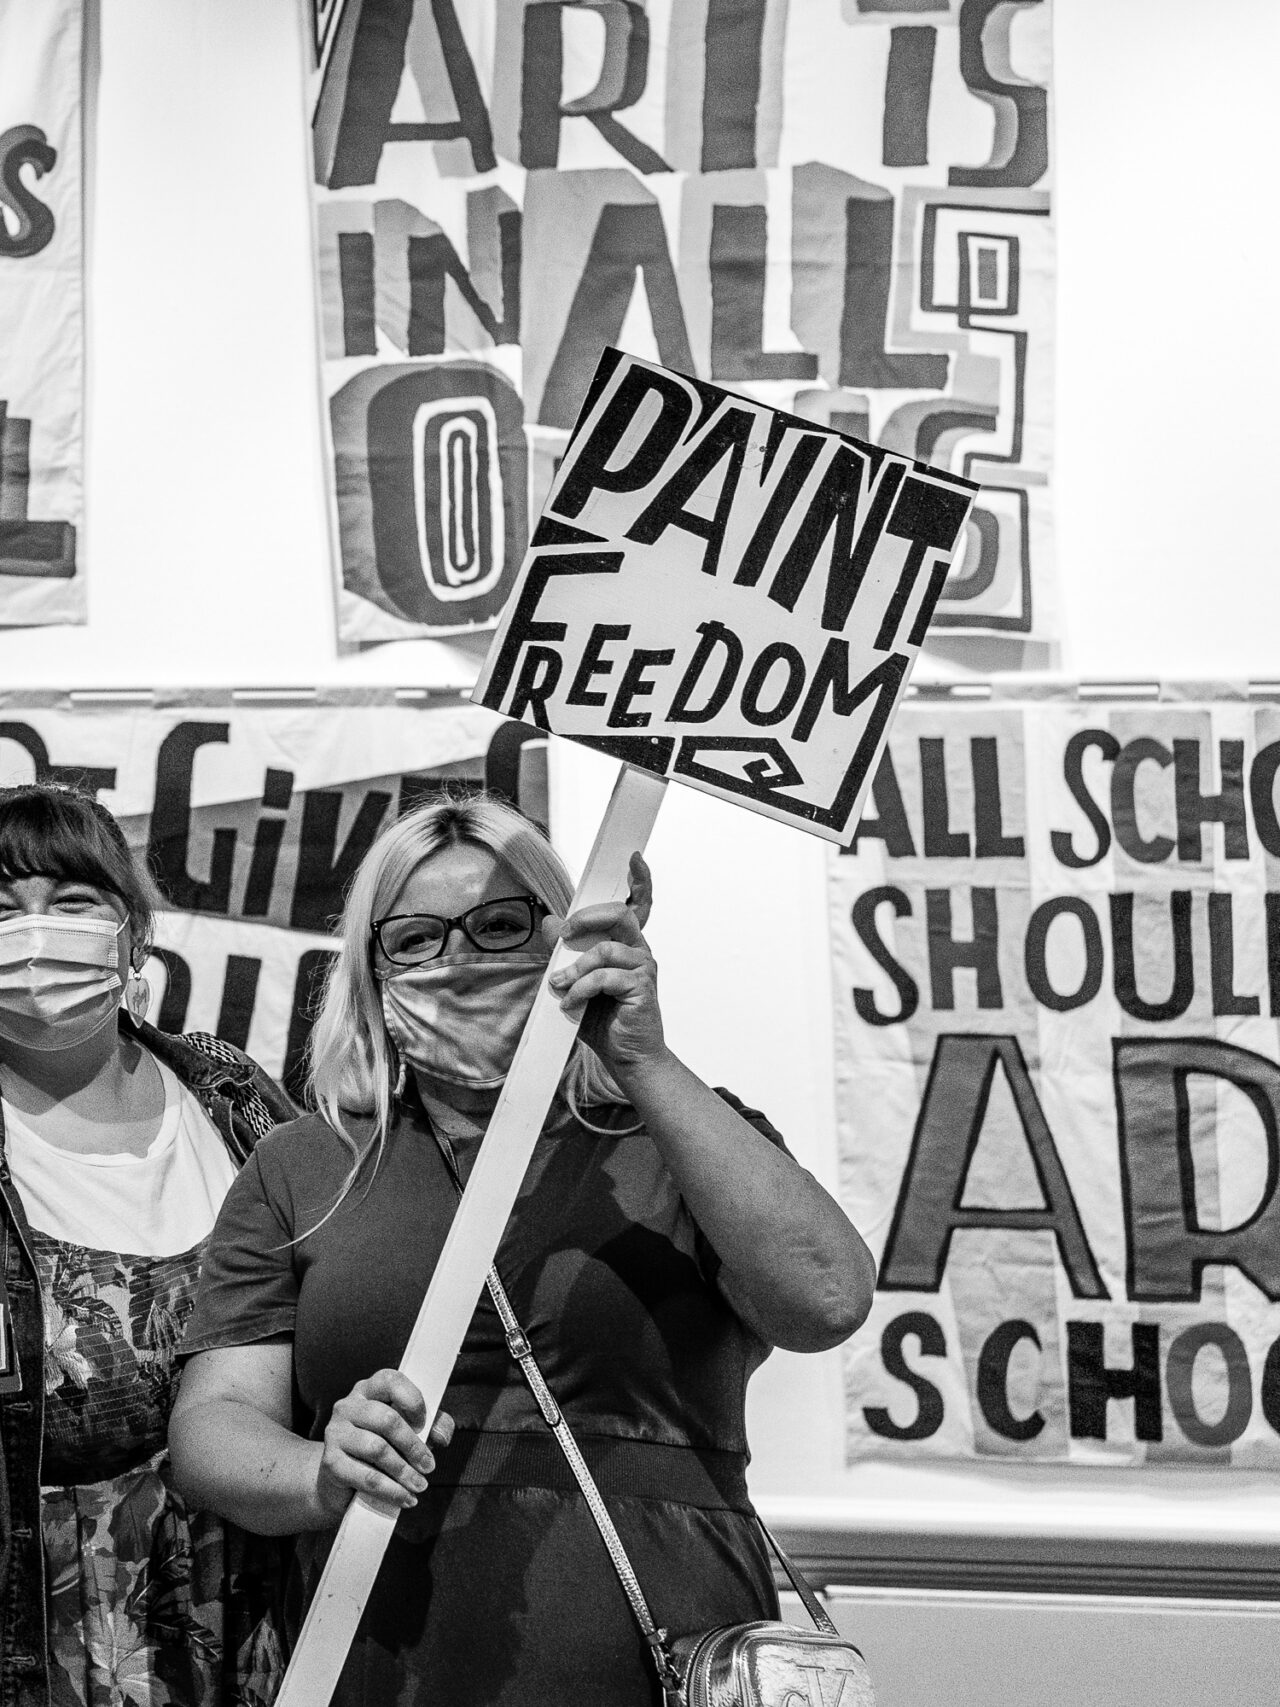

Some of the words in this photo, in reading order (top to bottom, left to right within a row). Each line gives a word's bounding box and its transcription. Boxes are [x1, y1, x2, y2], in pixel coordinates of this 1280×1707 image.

[325, 198, 522, 357] IN
[532, 190, 950, 428] ALL
[551, 364, 971, 651] PAINT
[483, 551, 909, 746] FREEDOM
[839, 736, 1025, 860] ALL
[851, 885, 1280, 1027] SHOUL
